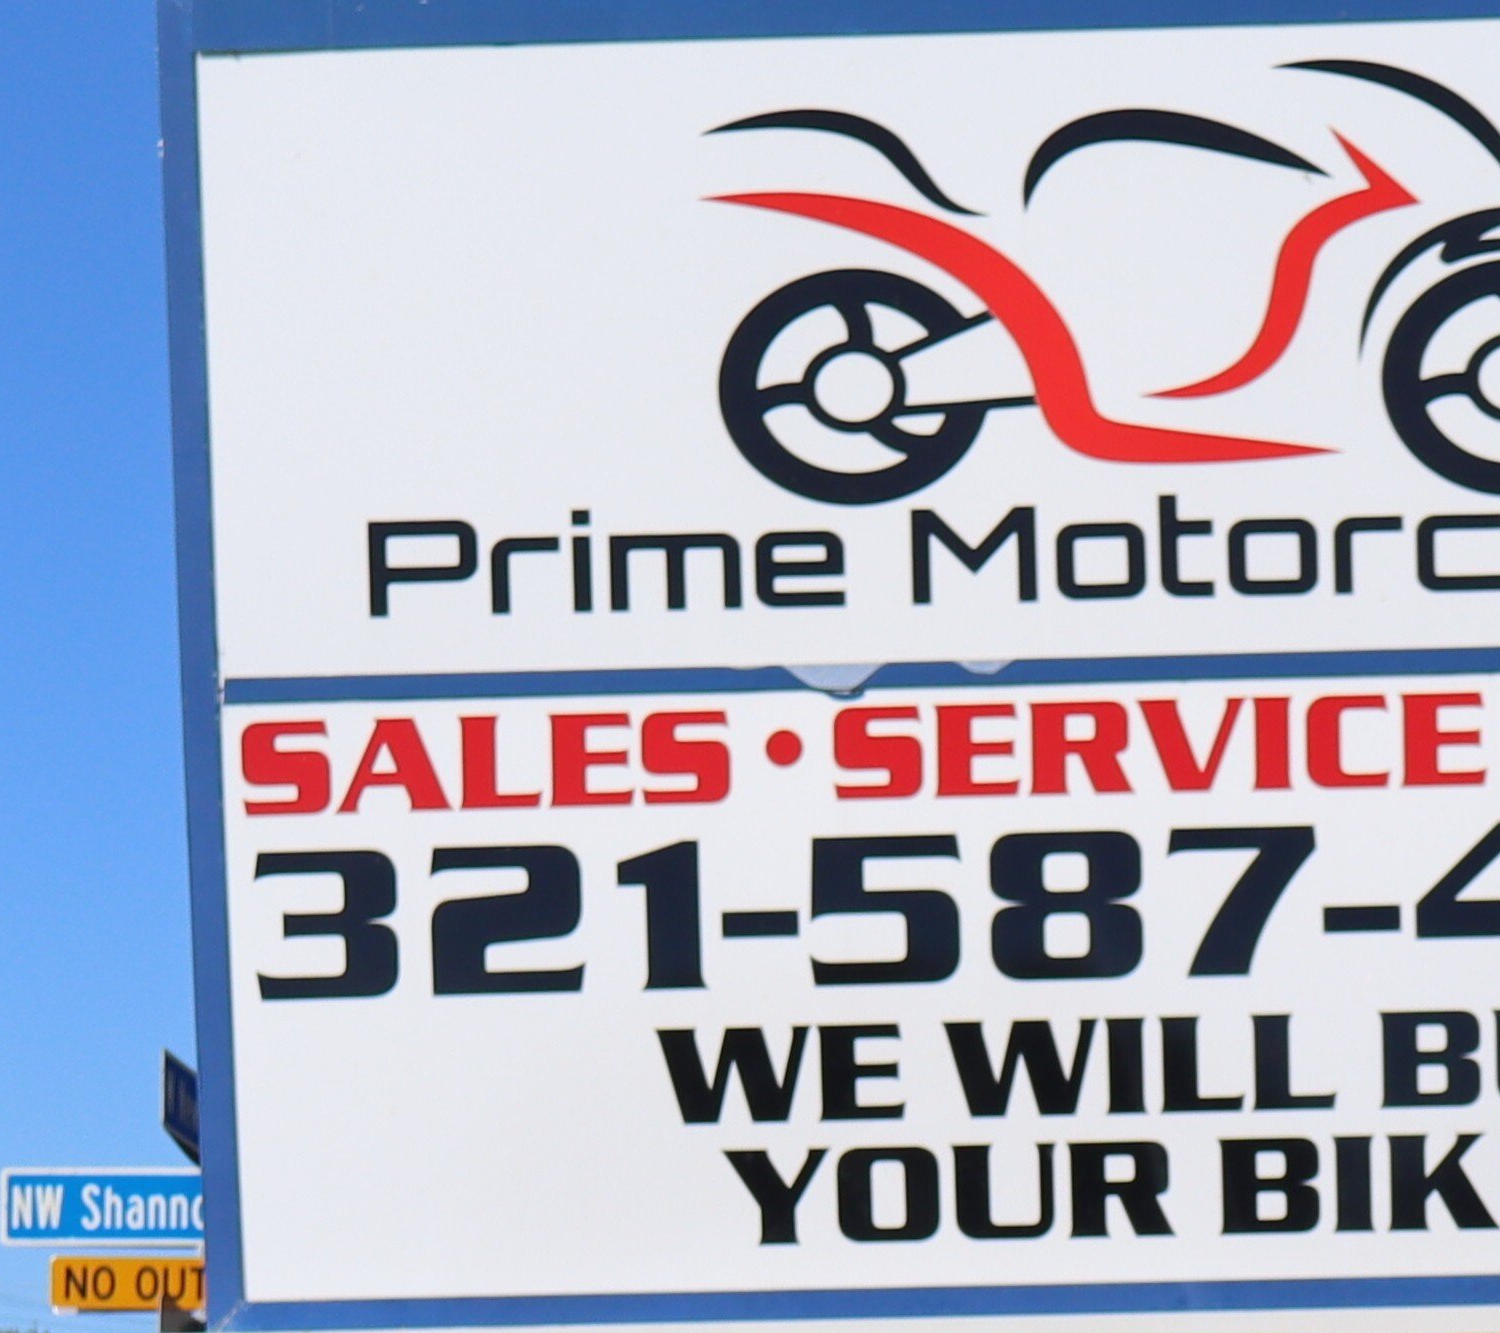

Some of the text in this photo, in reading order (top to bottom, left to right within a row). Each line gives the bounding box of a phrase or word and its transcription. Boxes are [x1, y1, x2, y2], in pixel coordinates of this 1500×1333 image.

[368, 519, 843, 616] Prime
[242, 712, 729, 814] SALES
[834, 693, 1484, 798] SERVICE
[657, 1024, 904, 1123] WE
[954, 1018, 1335, 1116] WILL
[11, 1184, 64, 1230] NW
[725, 1142, 1173, 1244] YOUR
[64, 1266, 116, 1300] NO
